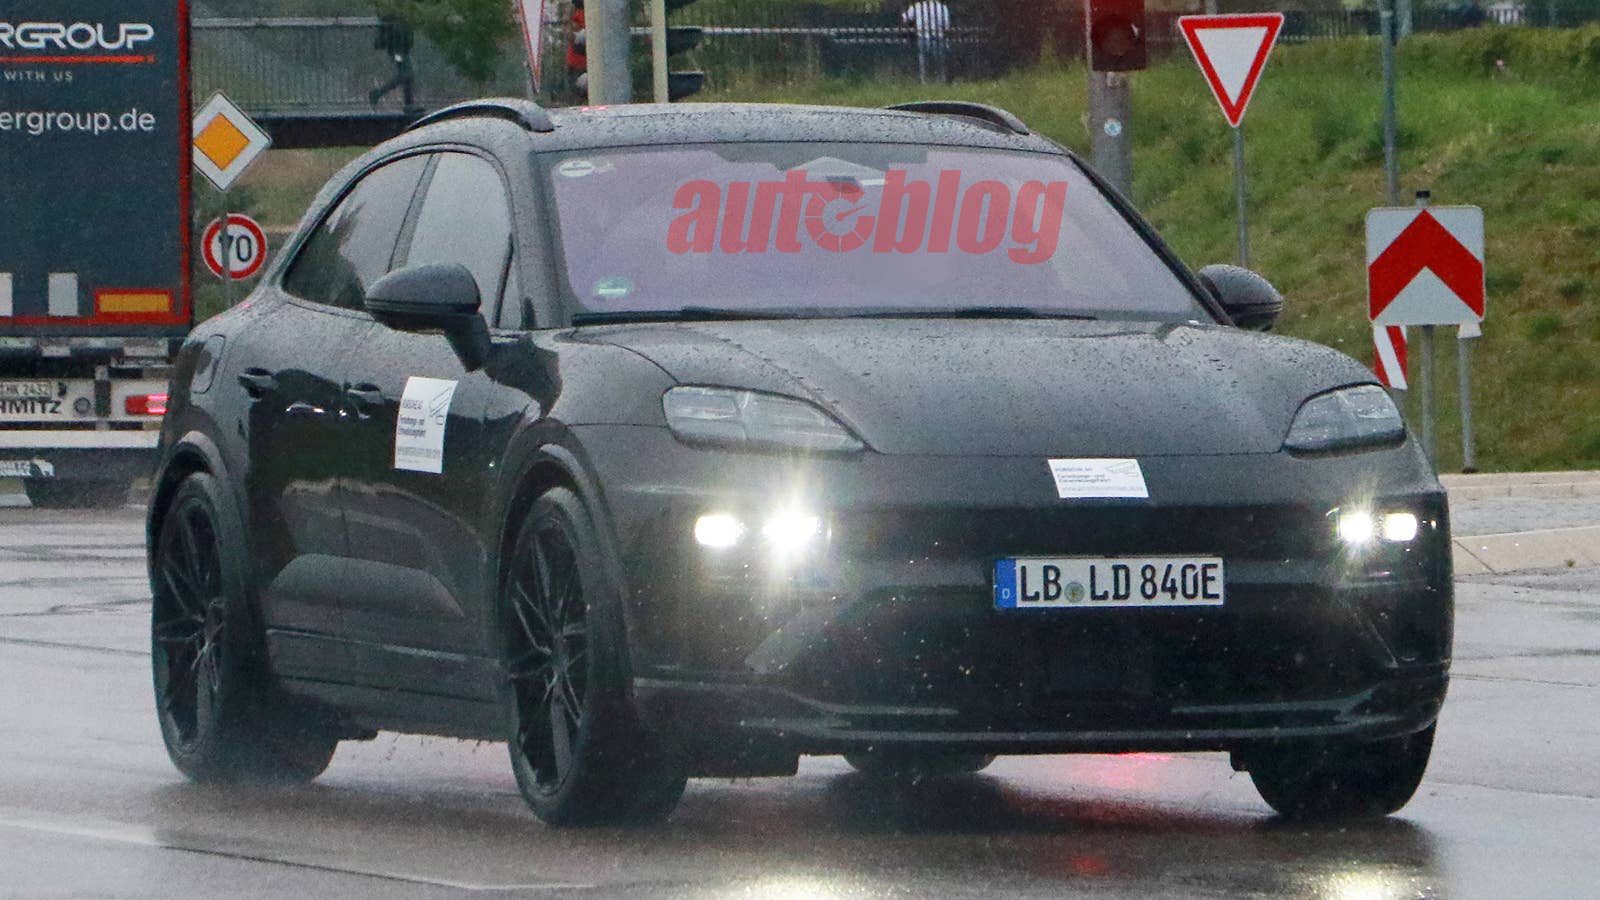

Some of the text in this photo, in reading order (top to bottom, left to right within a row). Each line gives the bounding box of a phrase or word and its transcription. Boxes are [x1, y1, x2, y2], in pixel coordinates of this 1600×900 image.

[4, 71, 73, 81] WITH US
[0, 108, 156, 136] ergroup.de
[1020, 563, 1220, 601] LB LD 840E
